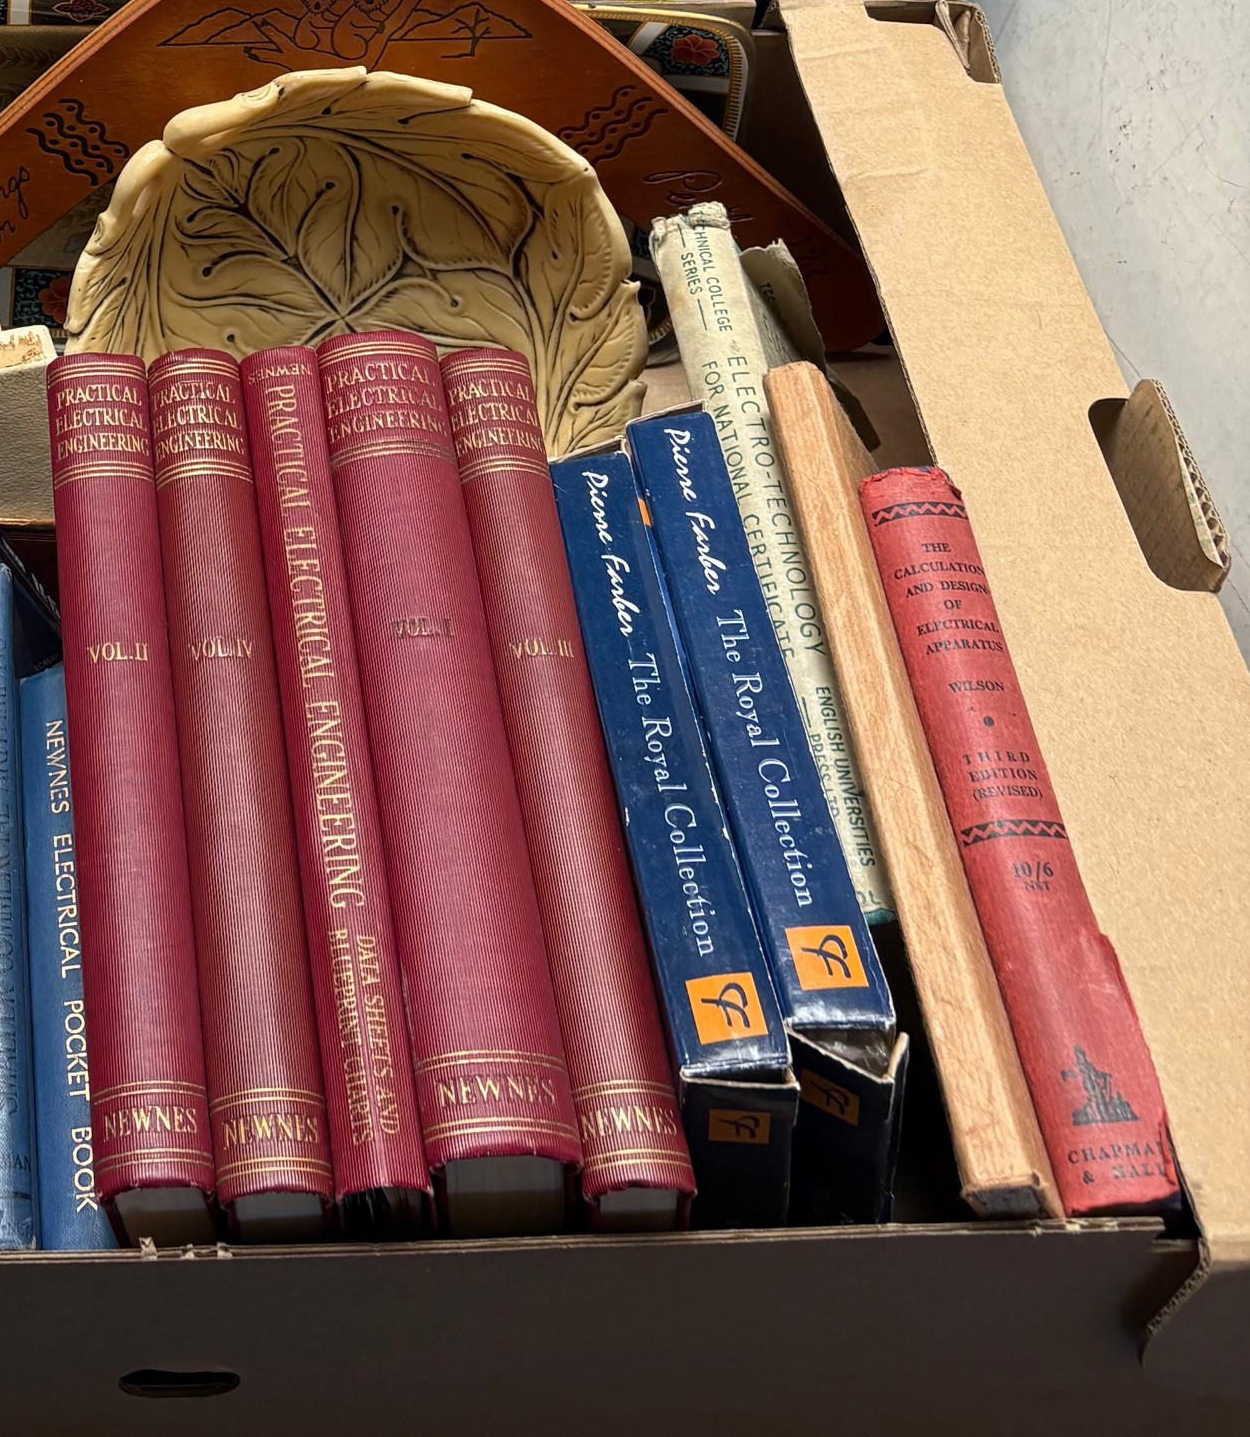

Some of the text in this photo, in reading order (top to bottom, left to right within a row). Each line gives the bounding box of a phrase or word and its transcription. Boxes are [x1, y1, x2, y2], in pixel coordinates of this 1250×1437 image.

[680, 252, 703, 296] SERIES
[706, 276, 733, 333] COLLEGE
[248, 363, 313, 385] NEWNES
[325, 363, 435, 394] PRACTICAL
[702, 360, 725, 398] FOR
[56, 384, 142, 411] PRACTICAL
[152, 381, 236, 412] PRACTICAL
[326, 385, 442, 419] ELECTRICAL
[448, 380, 534, 406] PRACTICAL
[55, 409, 147, 436] ELECTRICAL
[152, 407, 243, 436] ELECTRICAL
[328, 411, 447, 444] ENGINEERING
[450, 403, 540, 432] ELECTRICAL
[56, 433, 149, 462] ENGINEERING
[155, 432, 246, 463] ENGINEERING
[455, 428, 544, 460] ENGINEERING
[713, 403, 753, 507] NATIONAL
[726, 355, 826, 657] ELECTRO-TECHNOLOGY
[922, 542, 951, 553] THE
[894, 562, 986, 580] CALCULATION
[905, 580, 988, 598] AND DESIGN
[943, 599, 963, 610] OF
[716, 609, 751, 664] The
[916, 619, 999, 637] ELECTRICAL
[264, 384, 366, 909] PRACTICAL ELECTRICAL ENGINEERING
[925, 638, 1004, 655] APPARATUS
[628, 652, 661, 705] The
[948, 680, 1005, 693] WILSON
[731, 672, 781, 747] Royal
[641, 716, 688, 793] Royal
[962, 751, 1030, 765] THIRD
[815, 686, 845, 753] ENGLISH
[834, 755, 876, 867] UNIVERSITIES
[968, 767, 1038, 783] EDITION
[972, 785, 1043, 803] (REVISED)
[758, 758, 814, 907] Collection
[664, 803, 717, 957] Collection
[1011, 861, 1054, 881] 10/6
[45, 719, 99, 1213] NEWNES ELECTRICAL POCKET BOOK
[329, 929, 374, 1146] BLUEPRINT CHARTS
[356, 934, 400, 1135] DATA SHEETS AND
[435, 1072, 556, 1108] NEWNES
[103, 1105, 198, 1142] NEWNES
[223, 1113, 319, 1151] NEWNES
[581, 1105, 678, 1142] NEWNES
[1082, 1170, 1095, 1185] &
